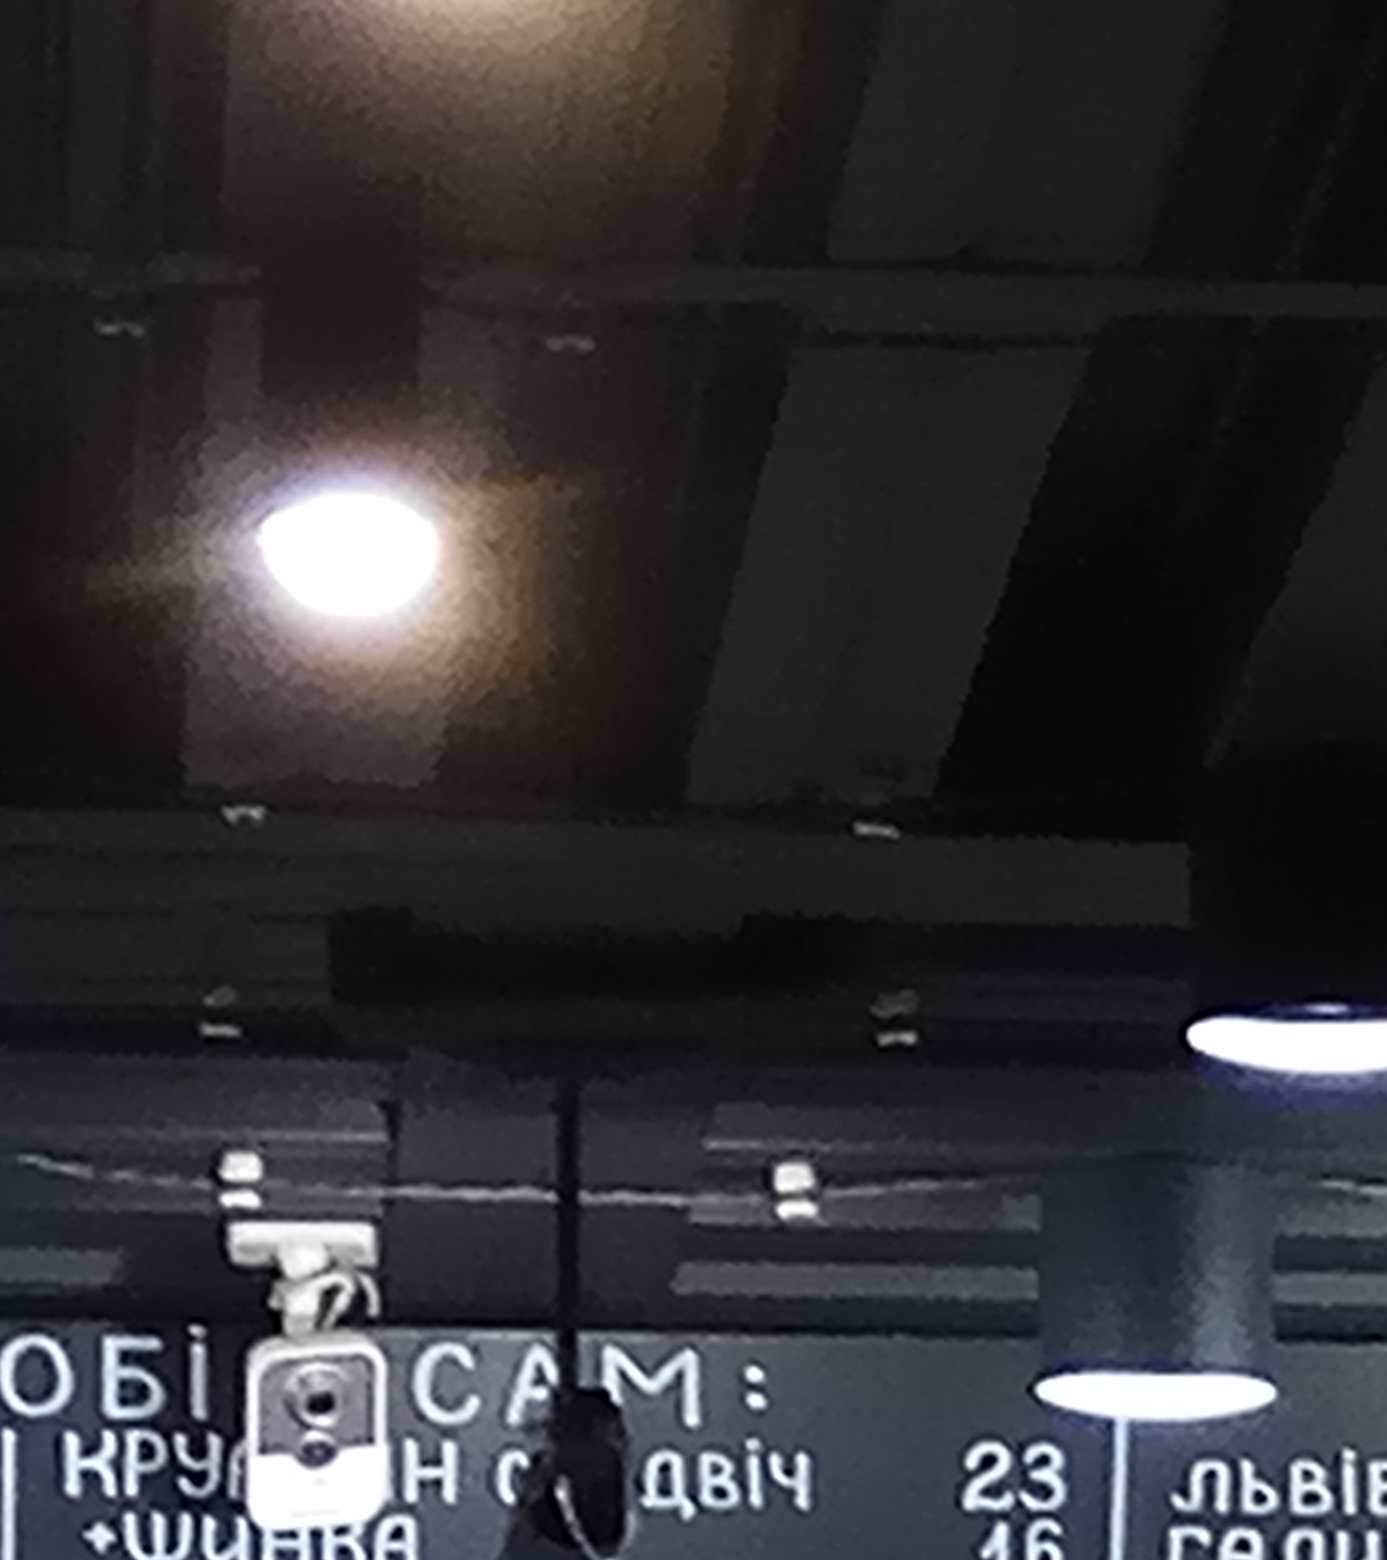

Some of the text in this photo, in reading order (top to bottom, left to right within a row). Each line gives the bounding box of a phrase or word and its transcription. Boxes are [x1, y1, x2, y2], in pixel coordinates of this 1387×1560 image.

[63, 1428, 1068, 1522] КРУН СДВІЧ 23
